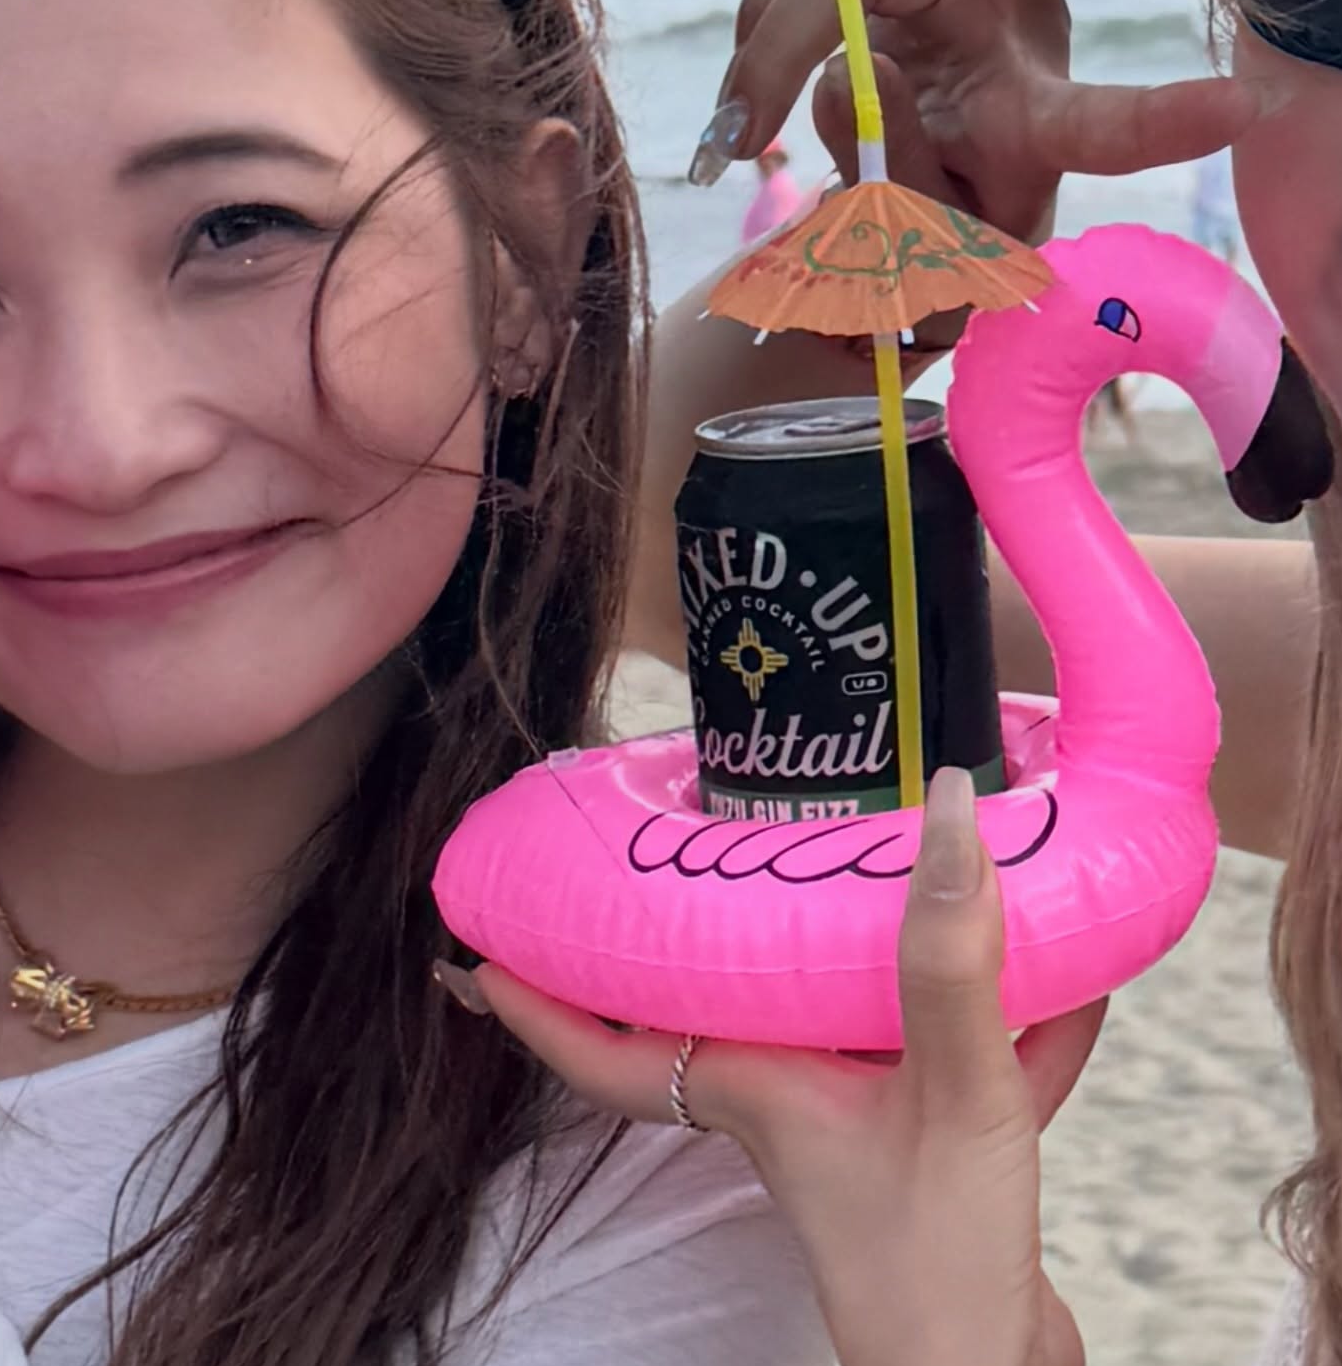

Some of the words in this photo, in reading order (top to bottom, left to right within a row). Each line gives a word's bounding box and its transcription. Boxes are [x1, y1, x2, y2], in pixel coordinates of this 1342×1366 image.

[681, 526, 787, 628] IXED
[811, 576, 889, 661] UP
[741, 594, 827, 673] COCKTAIL
